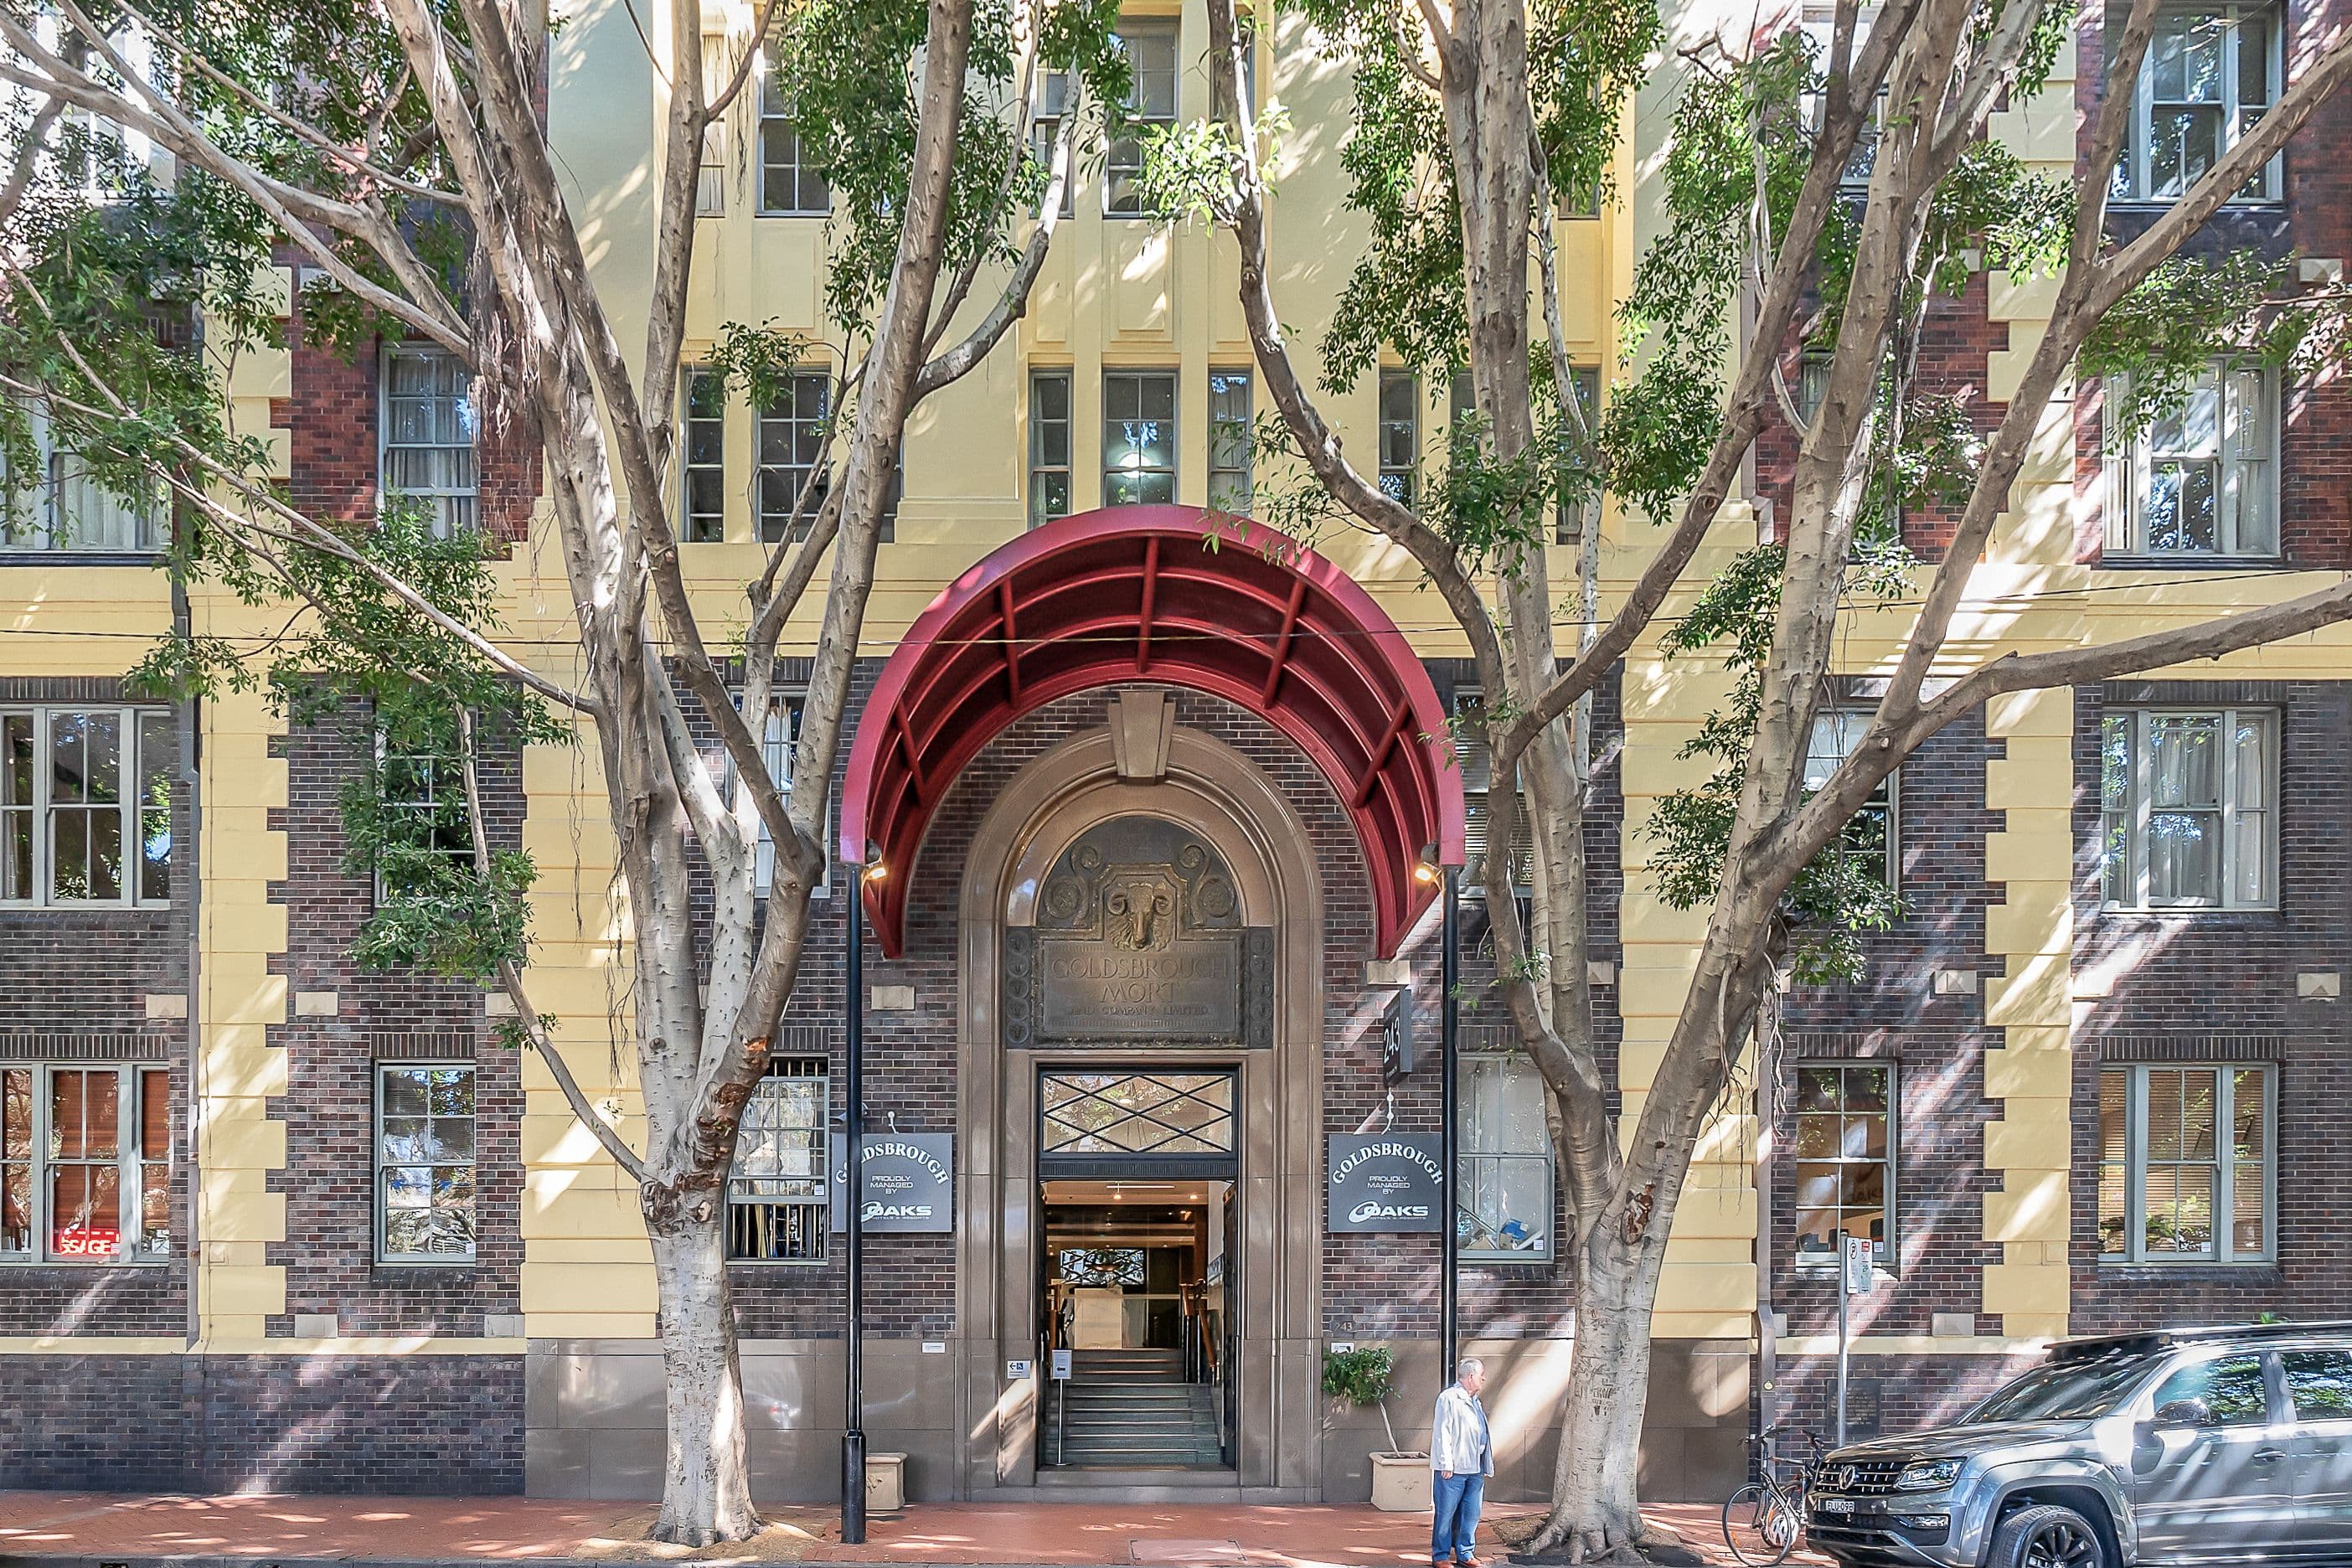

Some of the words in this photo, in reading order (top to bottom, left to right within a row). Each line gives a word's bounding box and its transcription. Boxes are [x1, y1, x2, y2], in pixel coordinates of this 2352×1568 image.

[1051, 957, 1227, 979] GOLDSBROUGH
[1099, 981, 1179, 1003] MORT
[1383, 1016, 1400, 1065] 243
[836, 1142, 950, 1185] GDSBROUGH
[1332, 1142, 1443, 1185] GOLDSBROUGH
[1334, 1322, 1353, 1331] 243
